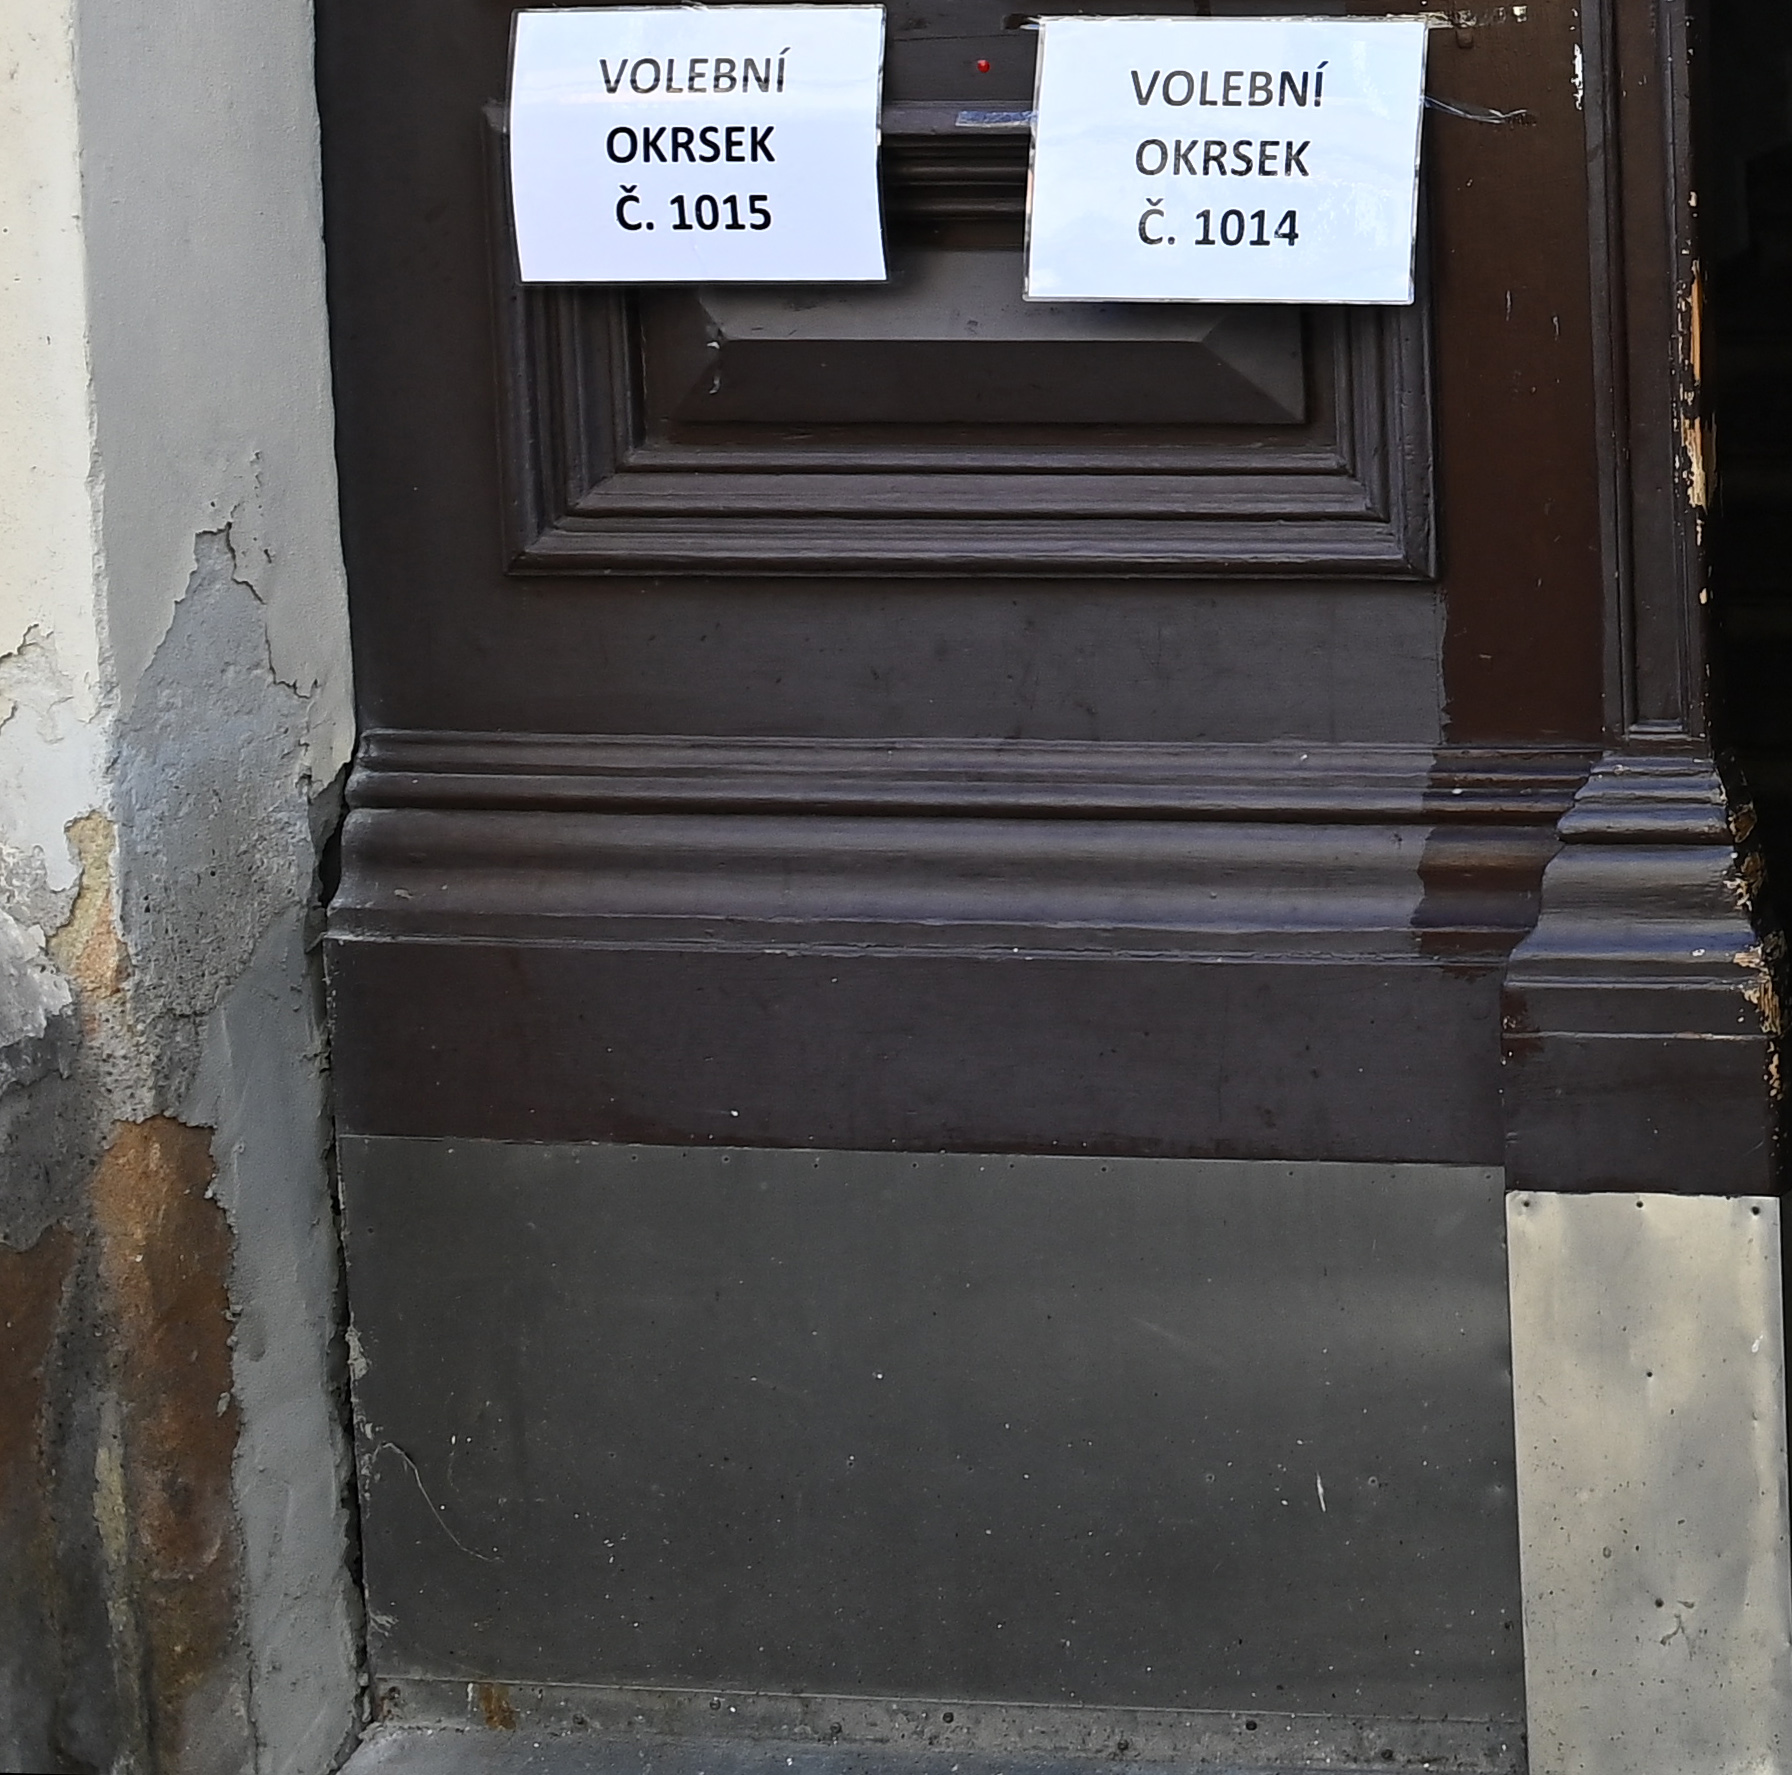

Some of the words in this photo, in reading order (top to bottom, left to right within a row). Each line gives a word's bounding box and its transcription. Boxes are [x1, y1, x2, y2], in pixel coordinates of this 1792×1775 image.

[599, 47, 789, 94] VOLEBNÍ
[1130, 60, 1329, 108] VOLEBNÍ
[605, 125, 776, 164] OKRSEK
[1135, 138, 1311, 177] OKRSEK
[615, 184, 655, 231] Č.
[669, 194, 773, 231] 1015
[1138, 198, 1176, 246] Č.
[1194, 208, 1299, 247] 1014
